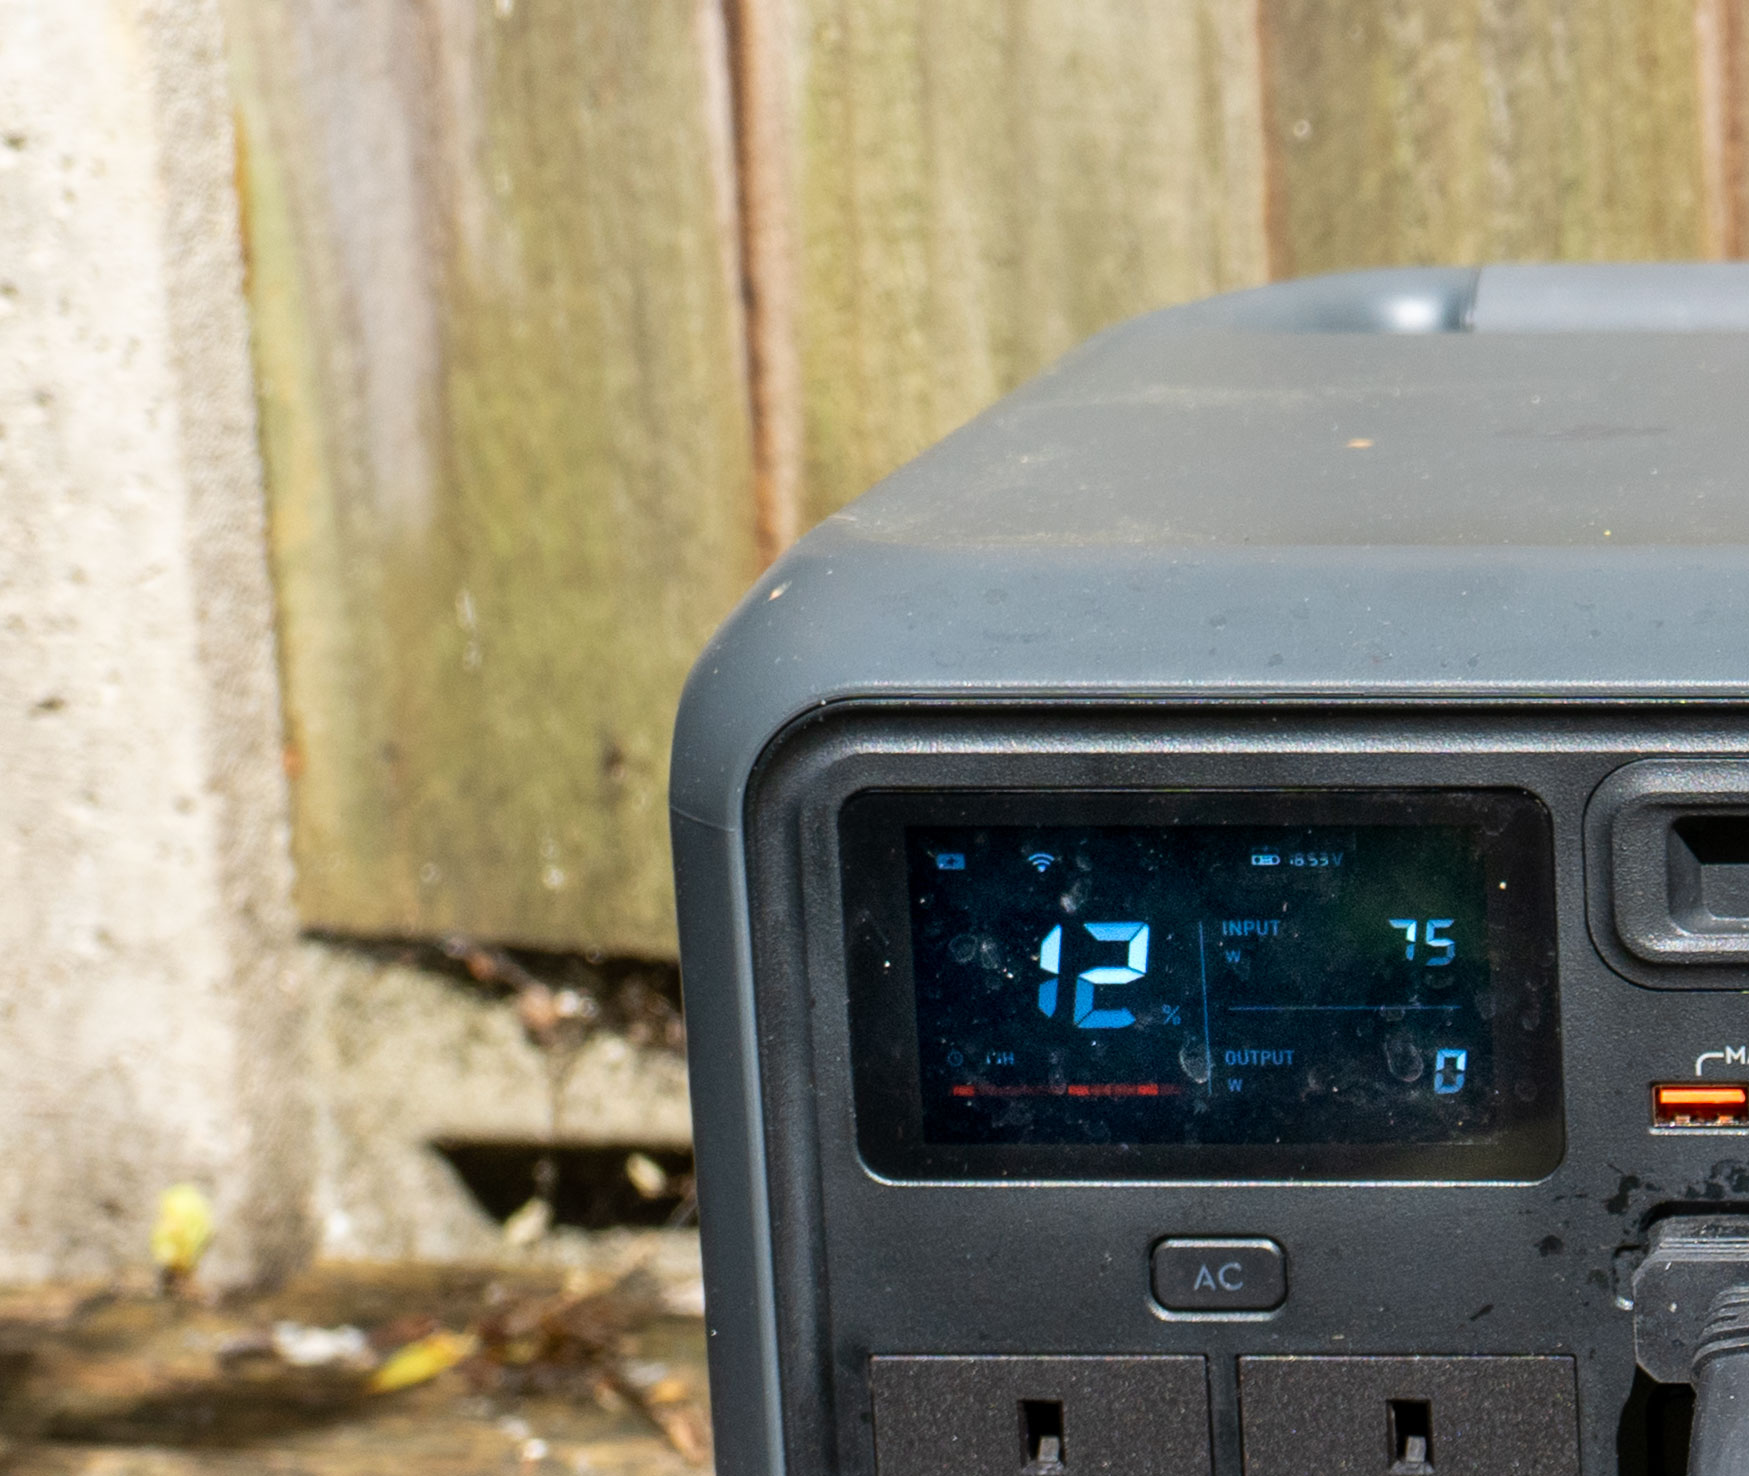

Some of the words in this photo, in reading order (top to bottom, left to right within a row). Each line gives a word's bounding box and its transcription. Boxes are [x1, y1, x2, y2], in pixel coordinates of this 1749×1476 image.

[1222, 919, 1280, 937] INPUT
[1388, 918, 1456, 966] 75
[1038, 921, 1149, 1029] 12
[1224, 1049, 1296, 1067] OUTPUT
[1434, 1048, 1468, 1095] 0
[1193, 1261, 1244, 1292] AC
